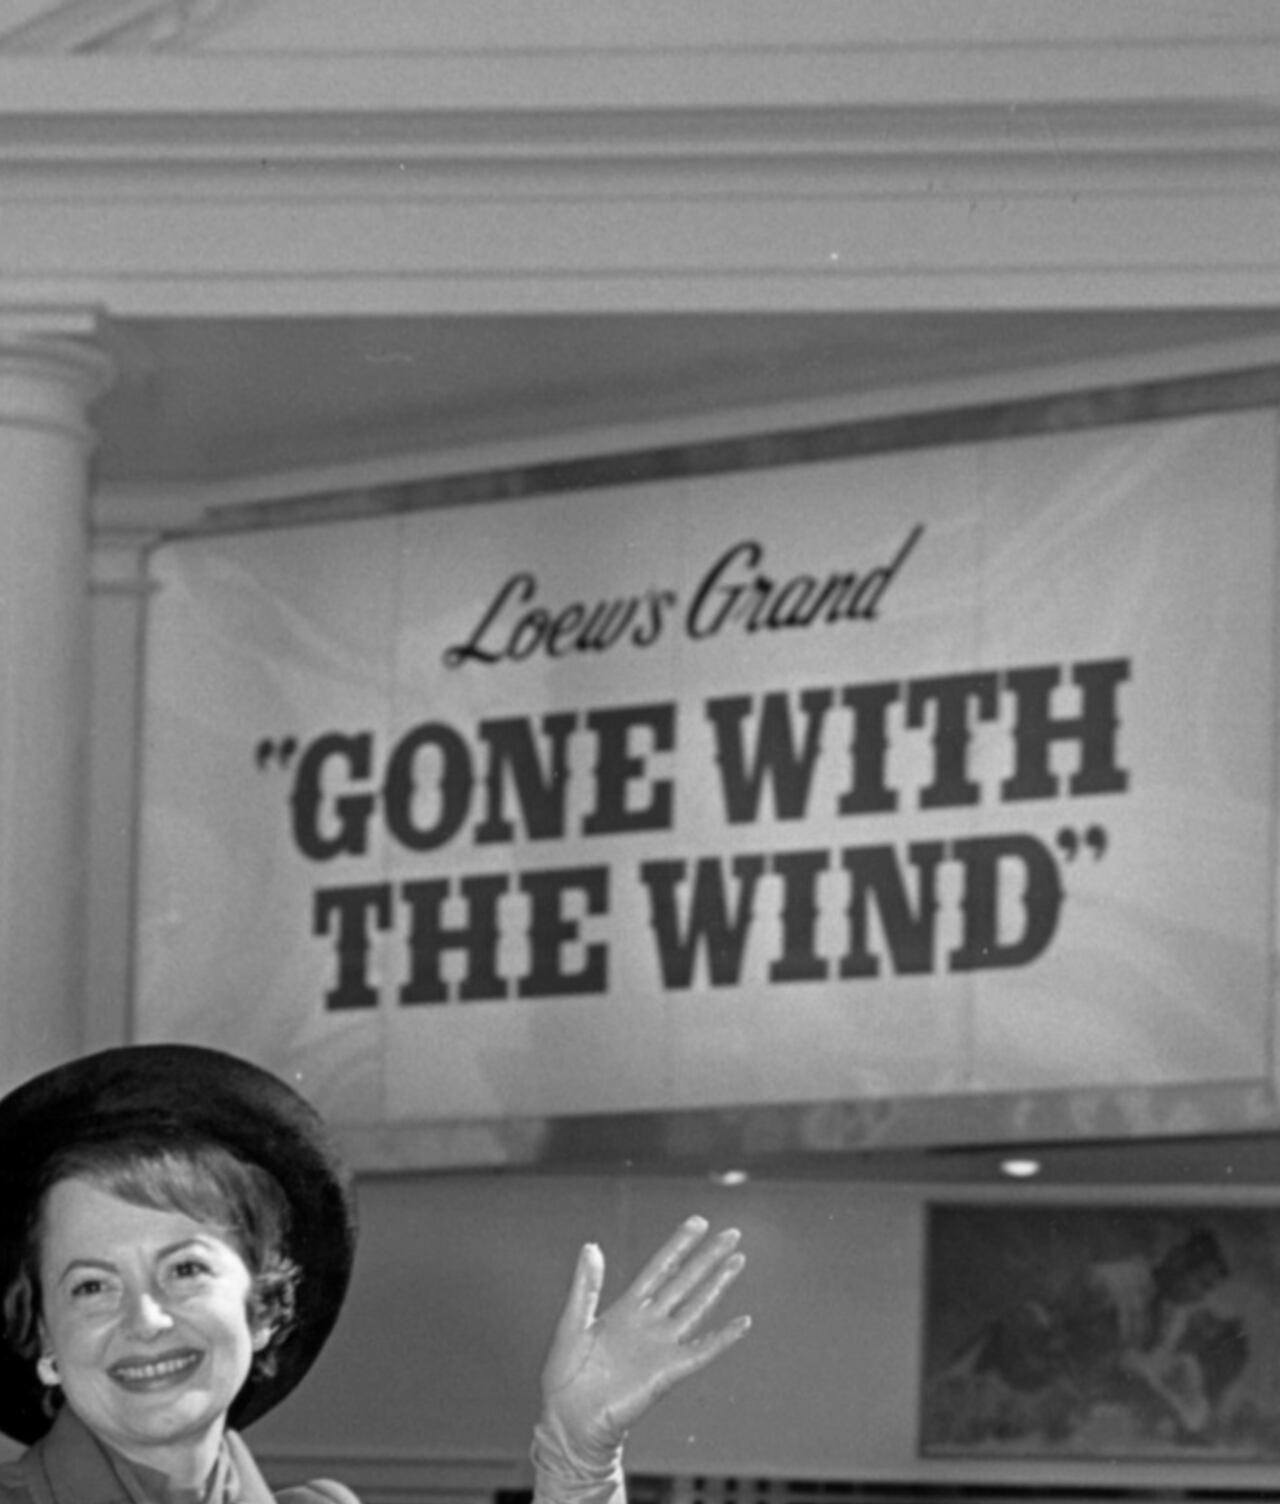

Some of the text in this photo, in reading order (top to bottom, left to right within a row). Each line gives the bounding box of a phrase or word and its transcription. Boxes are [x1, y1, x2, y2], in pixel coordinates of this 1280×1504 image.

[444, 524, 924, 668] Loew's Grand
[705, 657, 1132, 825] WITH
[313, 864, 611, 1012] THE
